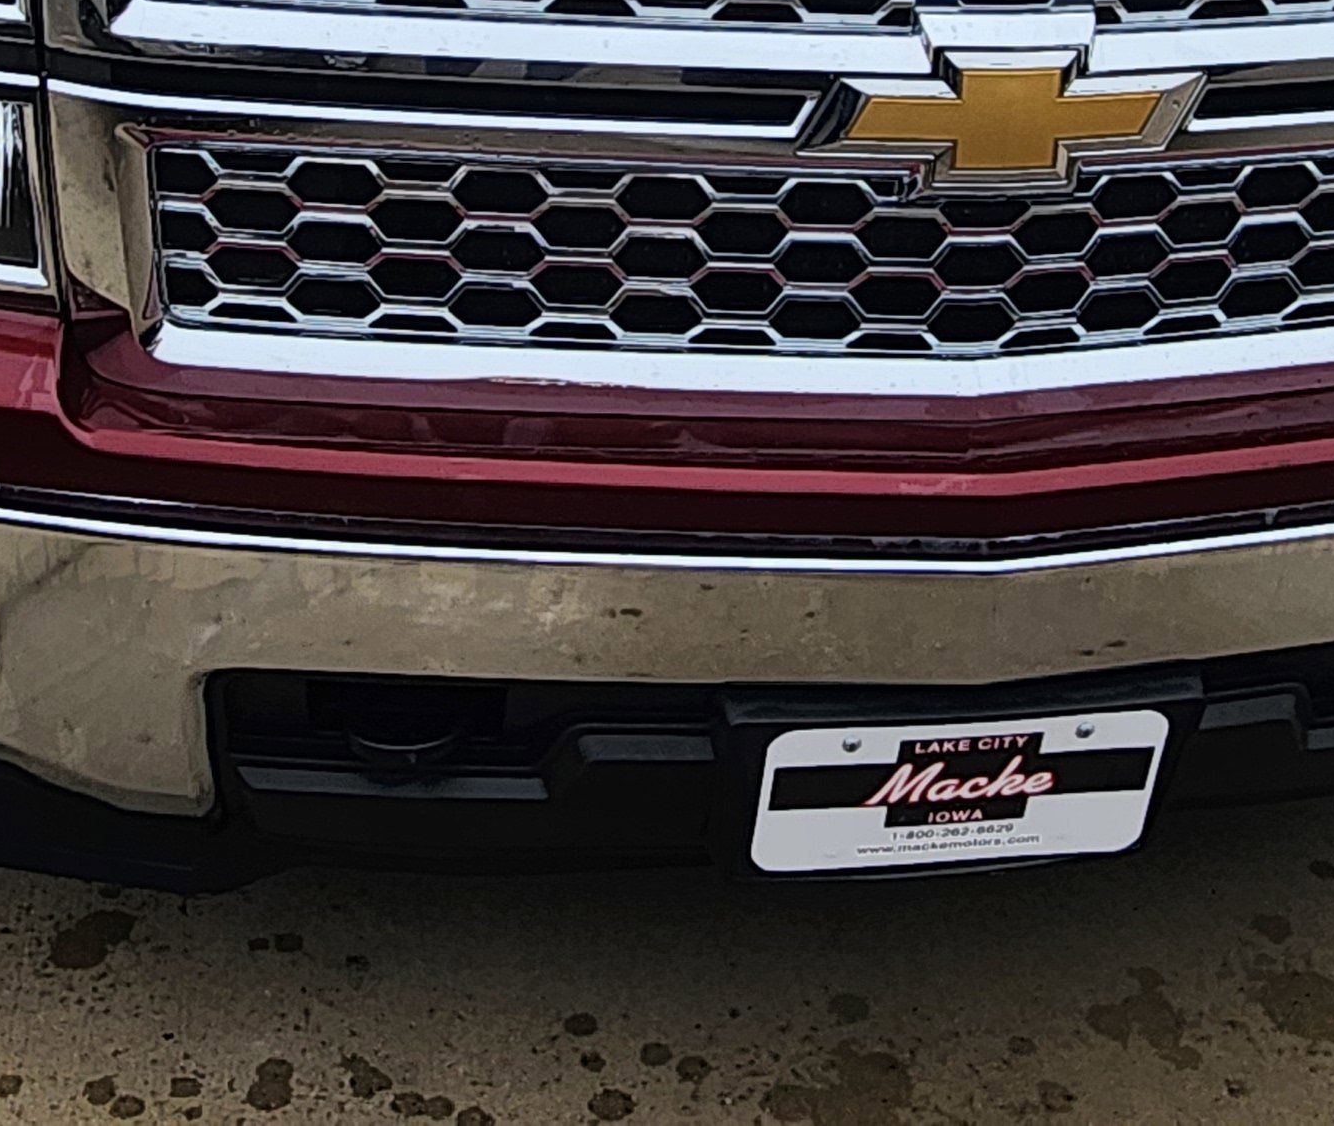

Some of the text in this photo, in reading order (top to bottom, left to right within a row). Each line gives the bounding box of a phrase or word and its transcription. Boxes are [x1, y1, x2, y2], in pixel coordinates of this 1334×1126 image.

[915, 735, 1029, 754] LAKE CITY
[863, 755, 1054, 806] Macke
[927, 808, 984, 823] IOWA
[856, 834, 1040, 855] www.mackemotors.com
